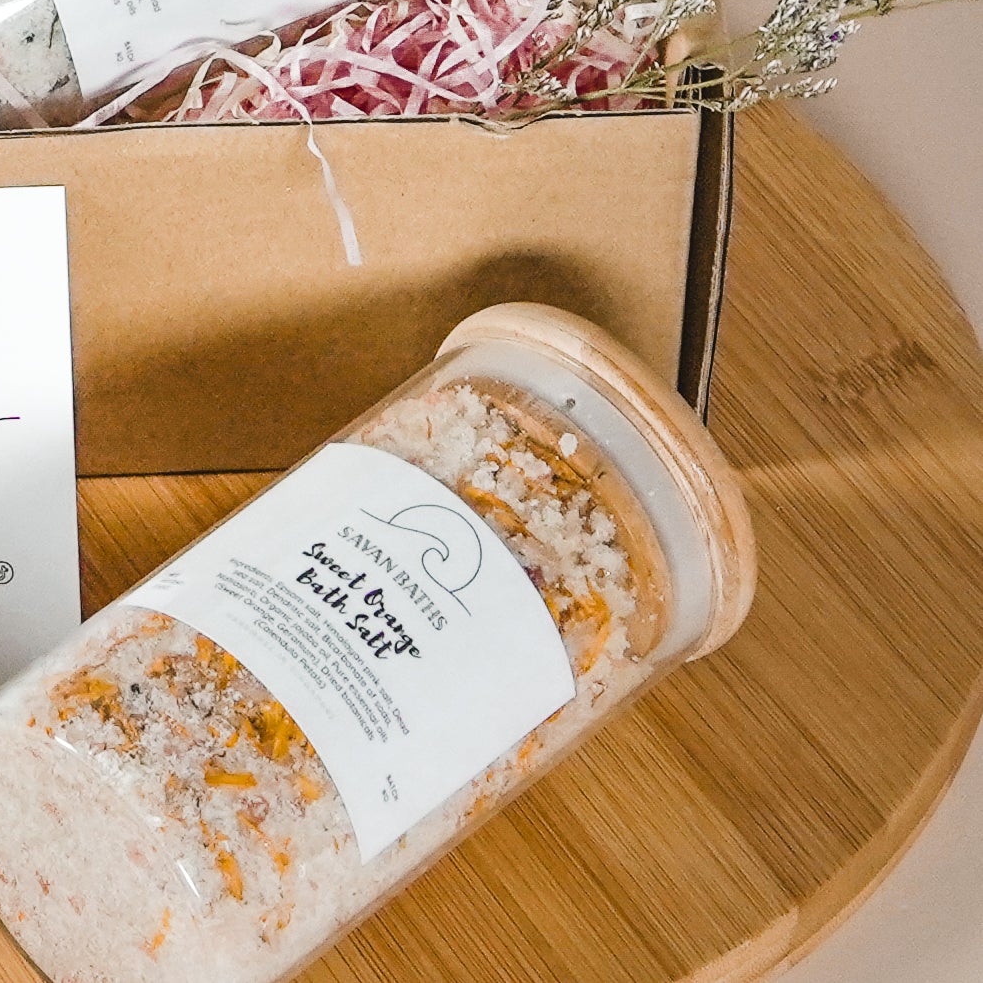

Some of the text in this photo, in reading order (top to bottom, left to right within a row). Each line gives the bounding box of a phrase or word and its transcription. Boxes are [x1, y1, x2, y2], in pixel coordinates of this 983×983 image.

[296, 567, 398, 660] Bath Salt
[302, 541, 422, 661] Sweet Orange
[337, 526, 448, 631] SAVAN BATHS
